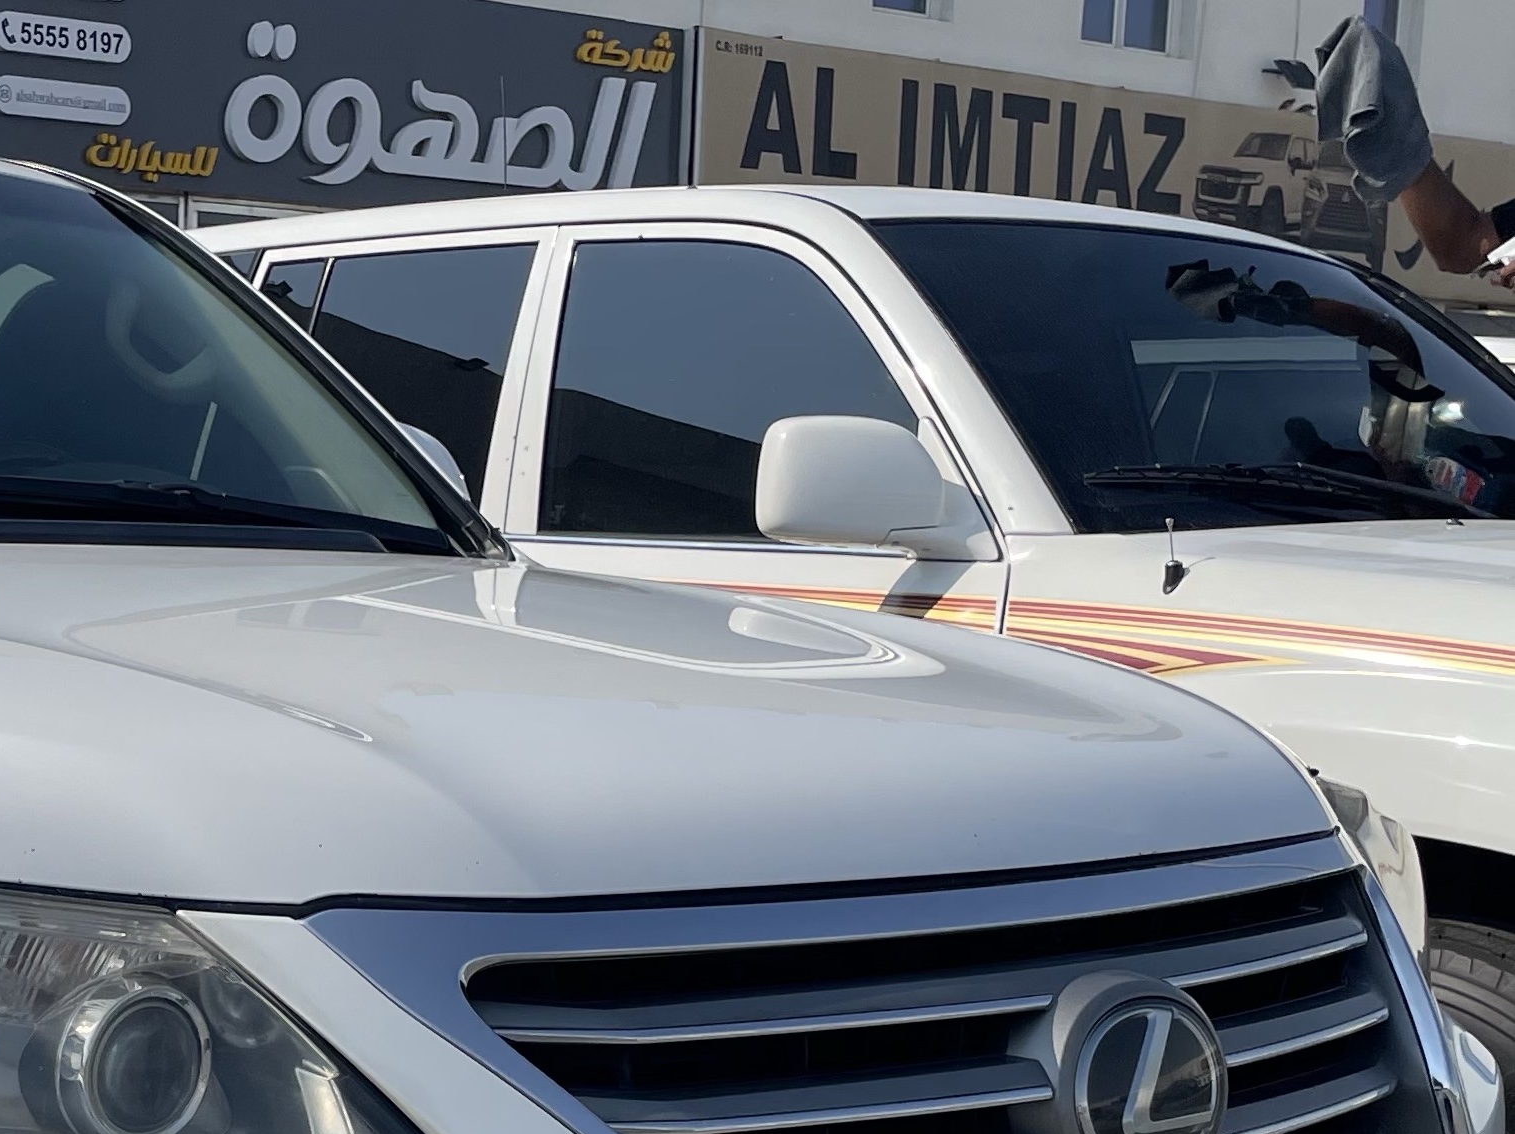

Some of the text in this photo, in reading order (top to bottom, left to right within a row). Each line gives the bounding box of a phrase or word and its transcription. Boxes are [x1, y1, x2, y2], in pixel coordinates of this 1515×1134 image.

[20, 22, 124, 55] 5555 8197
[576, 29, 675, 74] شركة
[225, 20, 658, 190] الصهوة
[85, 132, 220, 184] للسيارات
[739, 60, 859, 180] AL
[896, 77, 1187, 215] IMTIAZ
